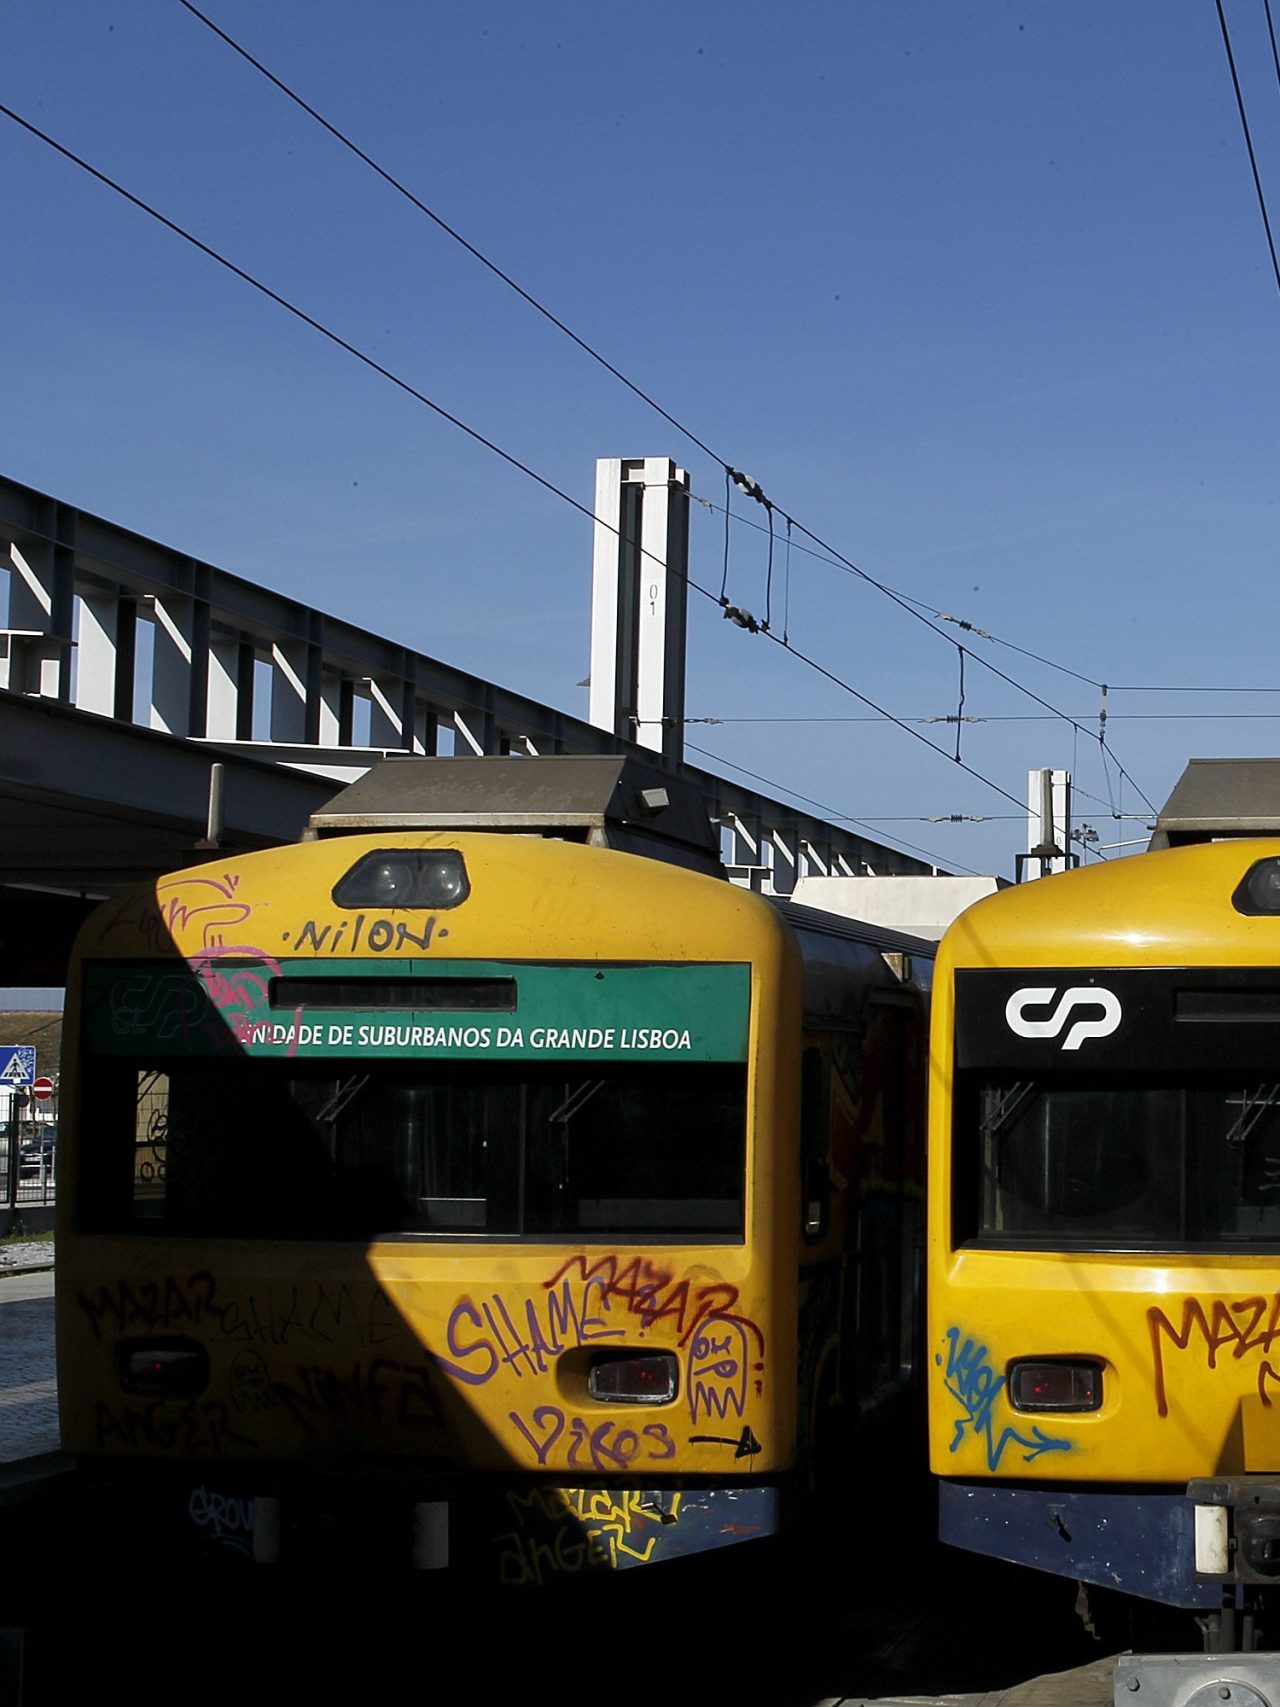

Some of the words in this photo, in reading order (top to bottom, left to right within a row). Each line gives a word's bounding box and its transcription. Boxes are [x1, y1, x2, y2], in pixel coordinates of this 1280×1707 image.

[328, 1025, 353, 1045] DE
[357, 1025, 491, 1047] SUBURBANOS
[496, 1027, 524, 1048] DA
[529, 1028, 615, 1049] GRANDE
[620, 1029, 692, 1049] LISBOA
[1005, 987, 1122, 1050] CP
